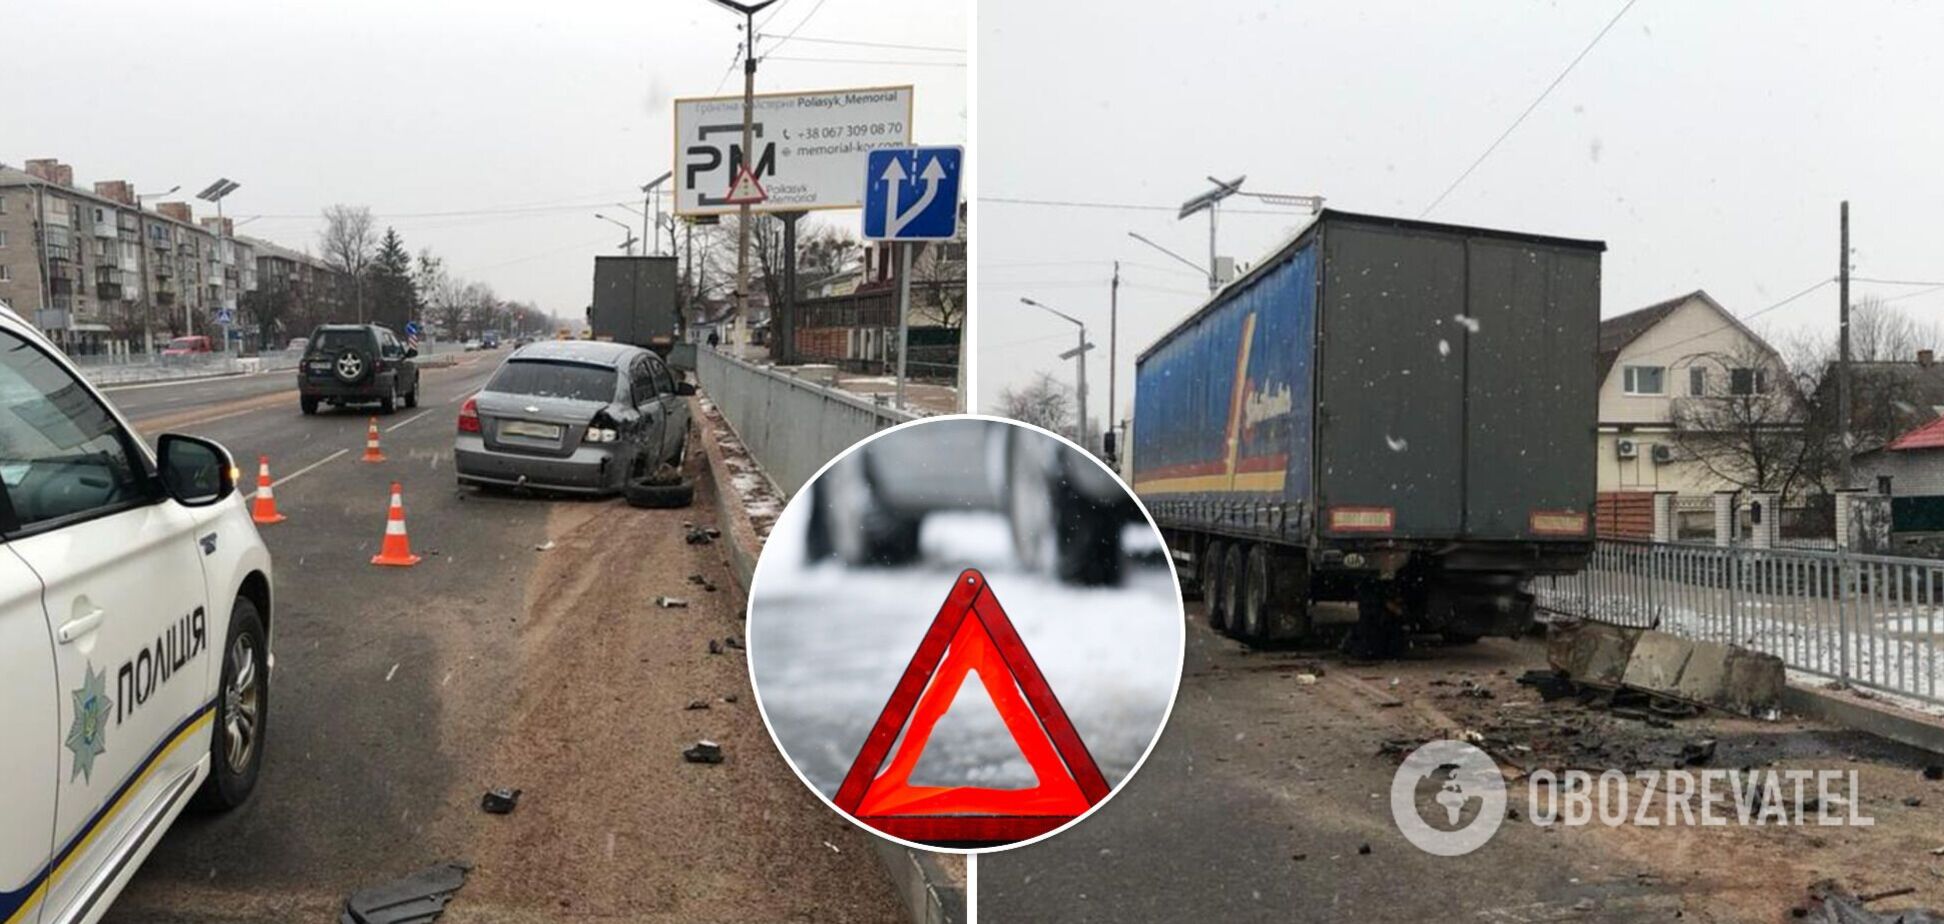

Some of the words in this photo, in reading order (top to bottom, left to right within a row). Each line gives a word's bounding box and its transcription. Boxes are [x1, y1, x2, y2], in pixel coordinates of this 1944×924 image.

[798, 128, 820, 140] +38
[822, 126, 844, 138] 067
[847, 124, 868, 137] 309
[870, 122, 886, 135] 08
[888, 121, 903, 134] 70
[686, 141, 776, 190] PM
[117, 605, 205, 725] ПОЛІЦІЯ
